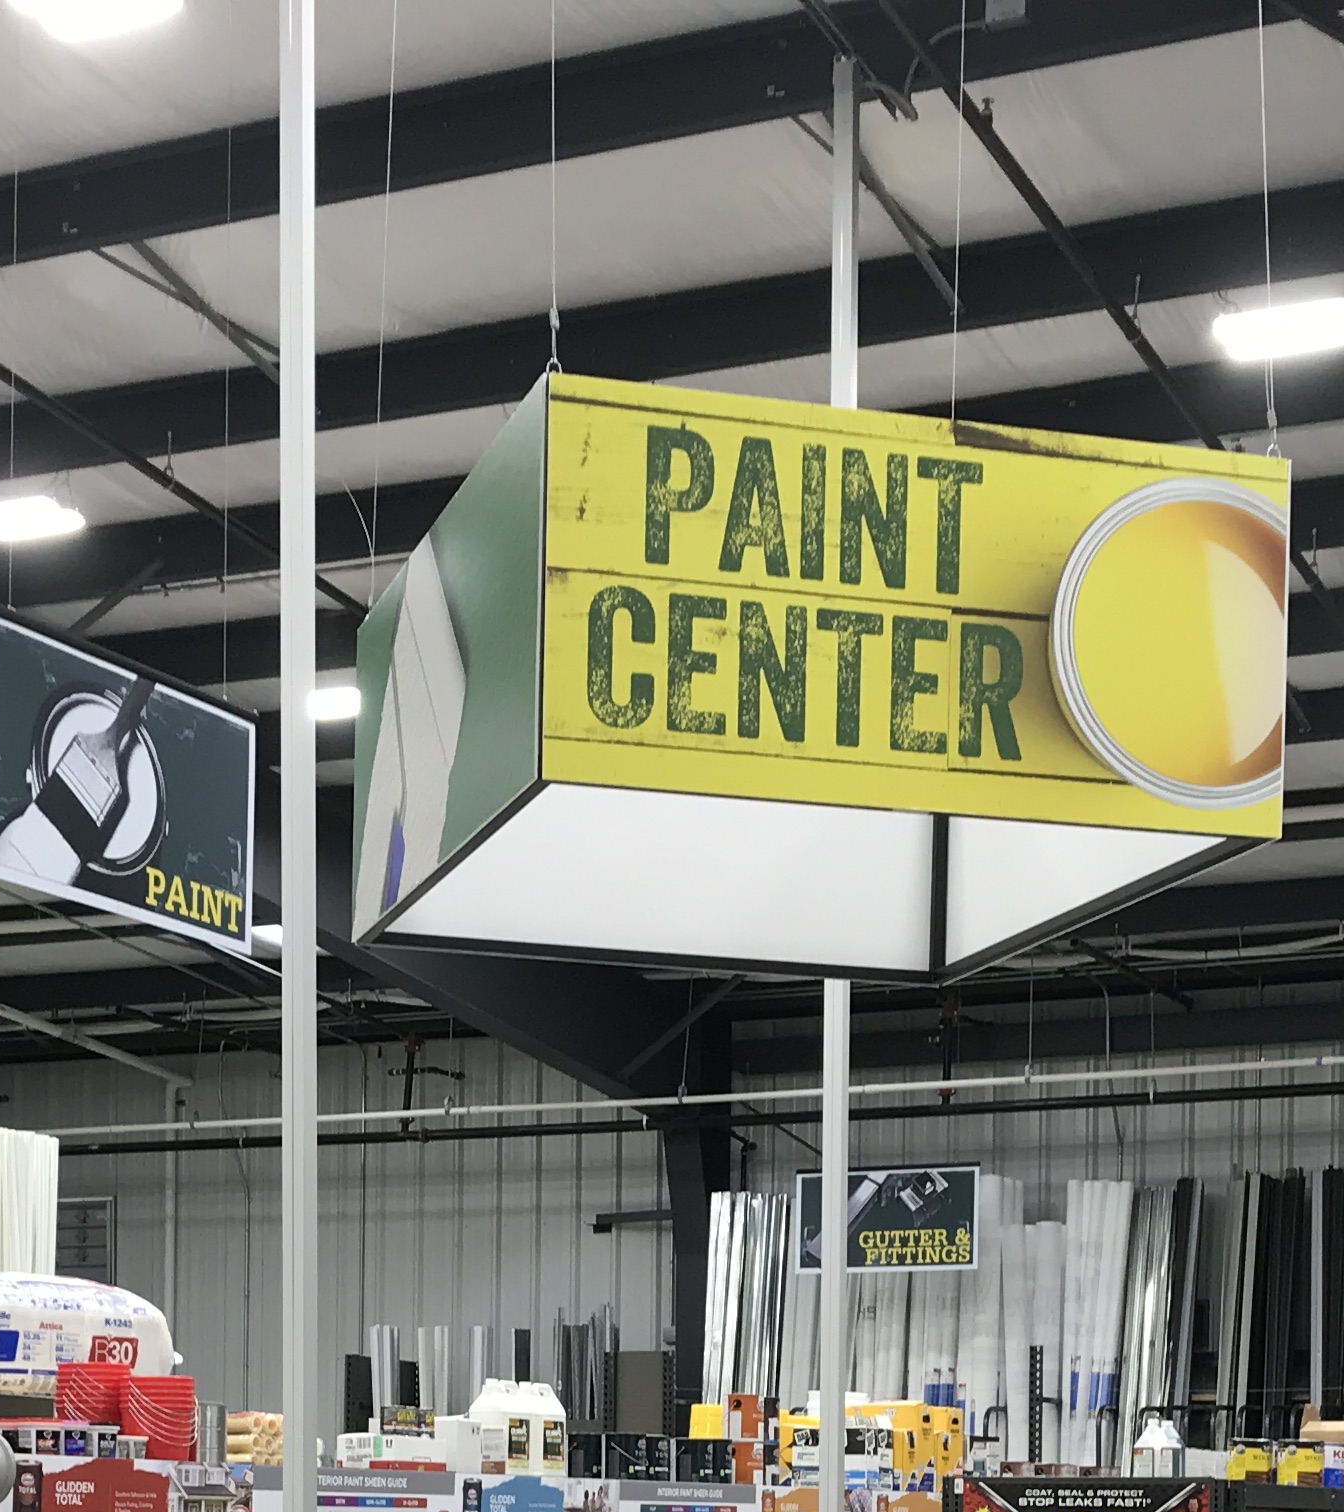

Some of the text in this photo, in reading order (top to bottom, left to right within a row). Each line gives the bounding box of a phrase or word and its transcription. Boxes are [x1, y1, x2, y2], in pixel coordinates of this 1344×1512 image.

[643, 422, 985, 597] PAINT
[586, 585, 1025, 762] CENTER
[145, 866, 243, 933] PAINT
[859, 1228, 971, 1249] GUTTER &
[865, 1245, 971, 1265] FITTINGS
[94, 1339, 133, 1365] R30
[55, 1481, 94, 1494] GLIDDEN
[318, 1475, 407, 1488] TERIOR PAINT SHEEN GUIDE
[55, 1493, 83, 1506] TOTAL
[490, 1494, 515, 1505] GLIDDEN
[694, 1489, 708, 1498] SHEEN
[709, 1489, 723, 1498] GUIDE
[1025, 1489, 1054, 1498] COAT,
[1058, 1489, 1084, 1497] SEAL
[1087, 1489, 1094, 1497] &
[1018, 1497, 1147, 1508] STOP LEAKS FAST!
